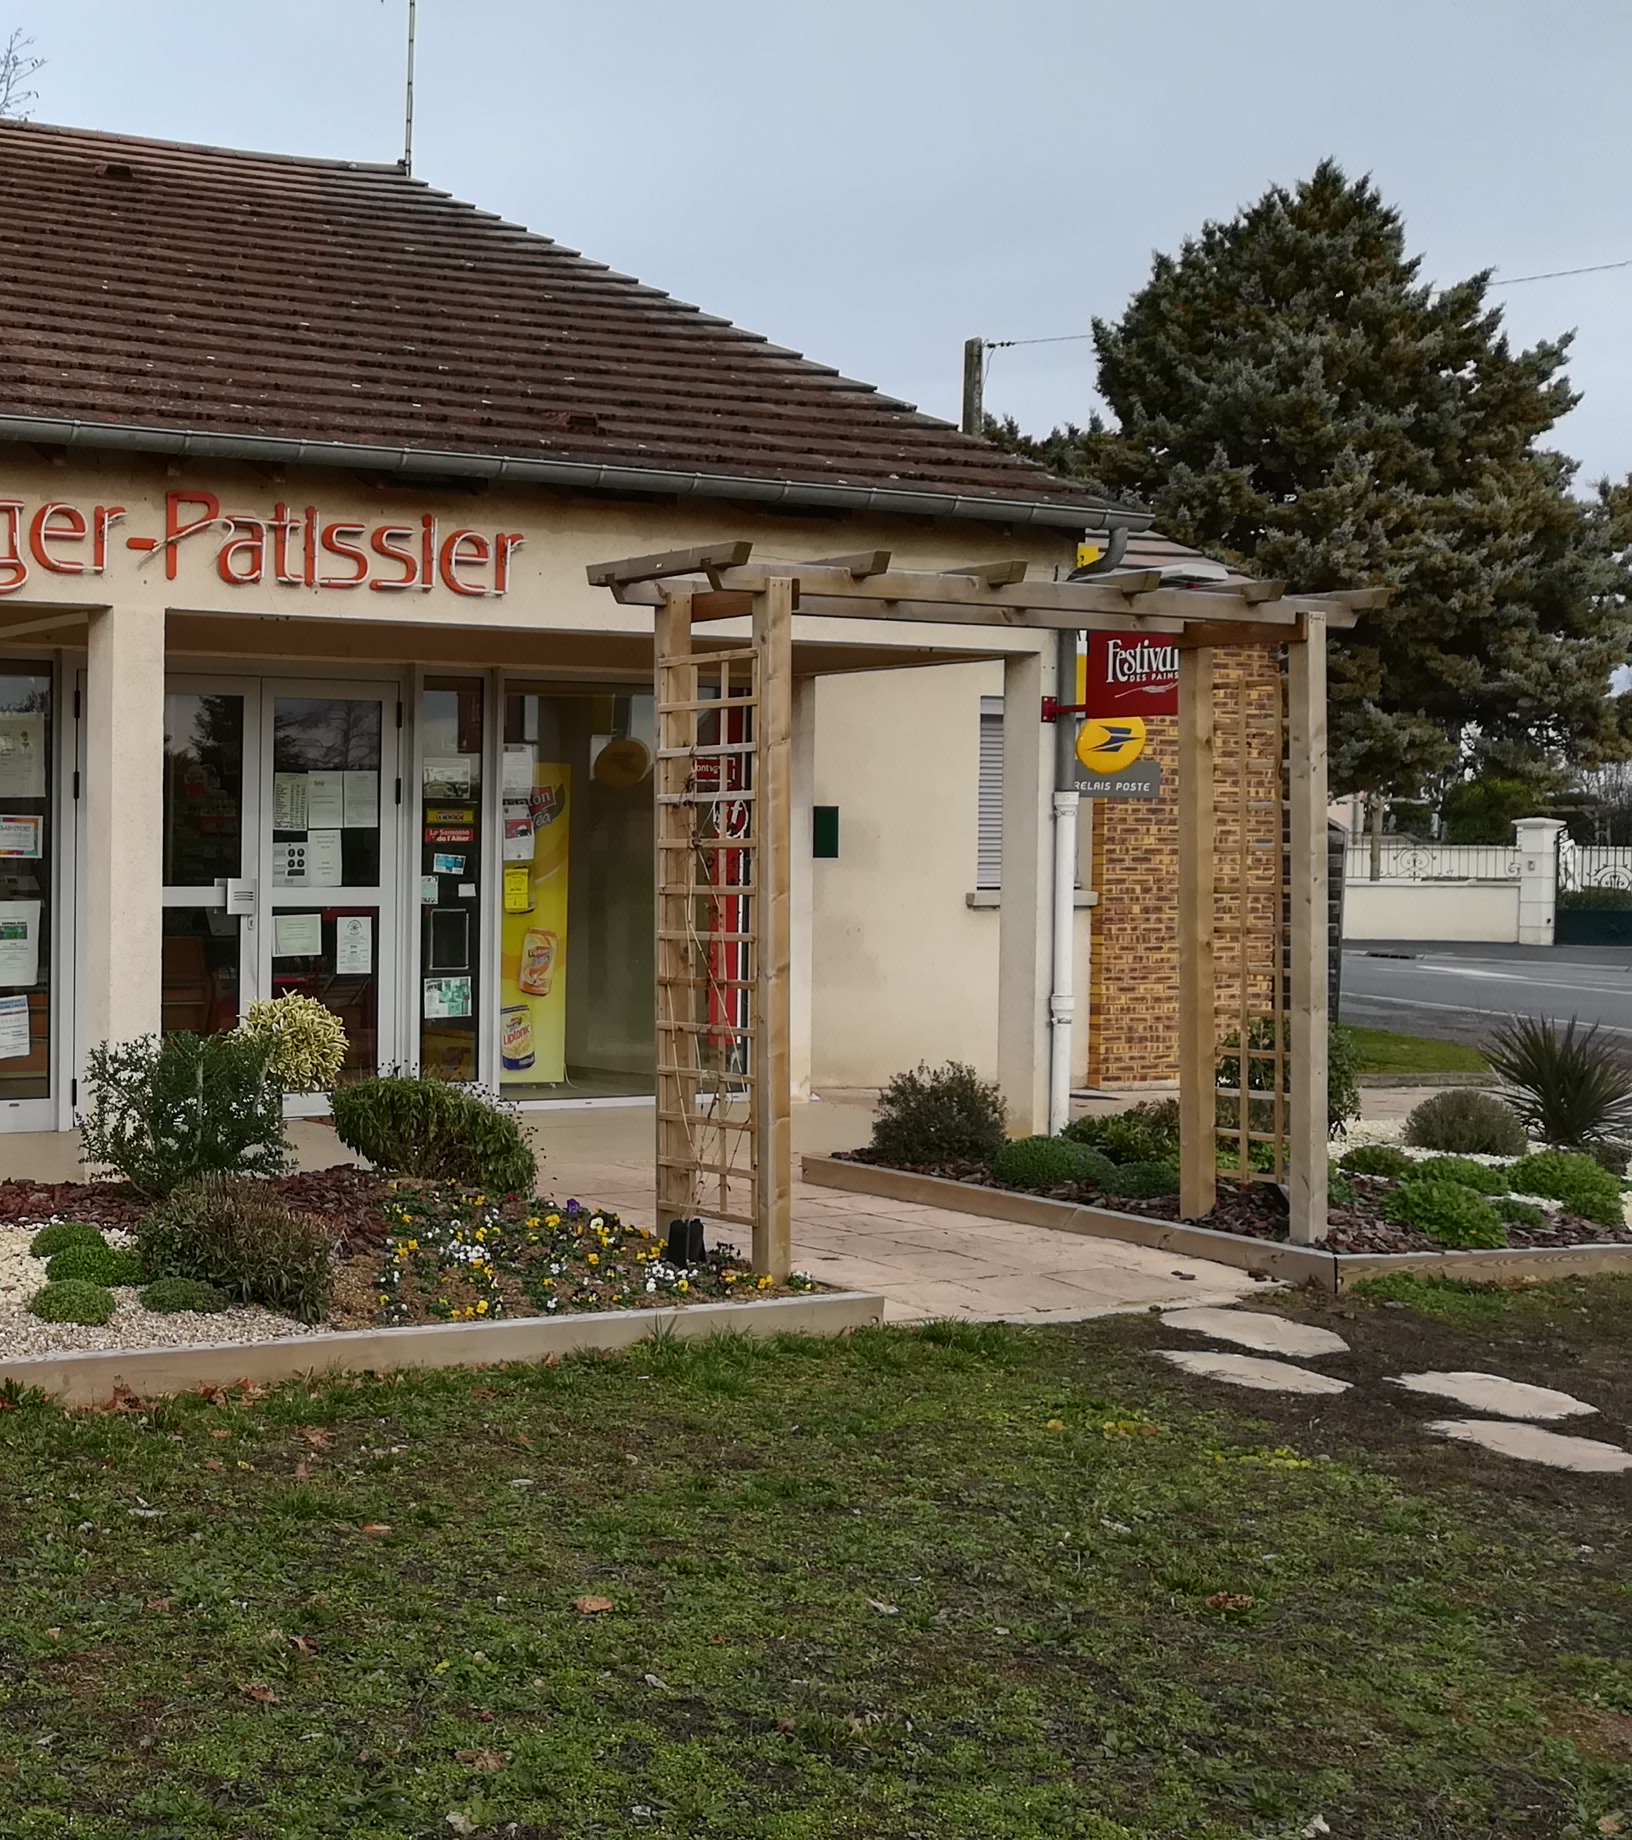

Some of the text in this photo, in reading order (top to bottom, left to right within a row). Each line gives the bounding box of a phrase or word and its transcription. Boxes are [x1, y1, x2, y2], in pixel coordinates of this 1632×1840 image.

[1130, 671, 1180, 682] DES PAINS
[1074, 781, 1151, 792] RELAIS POSTE
